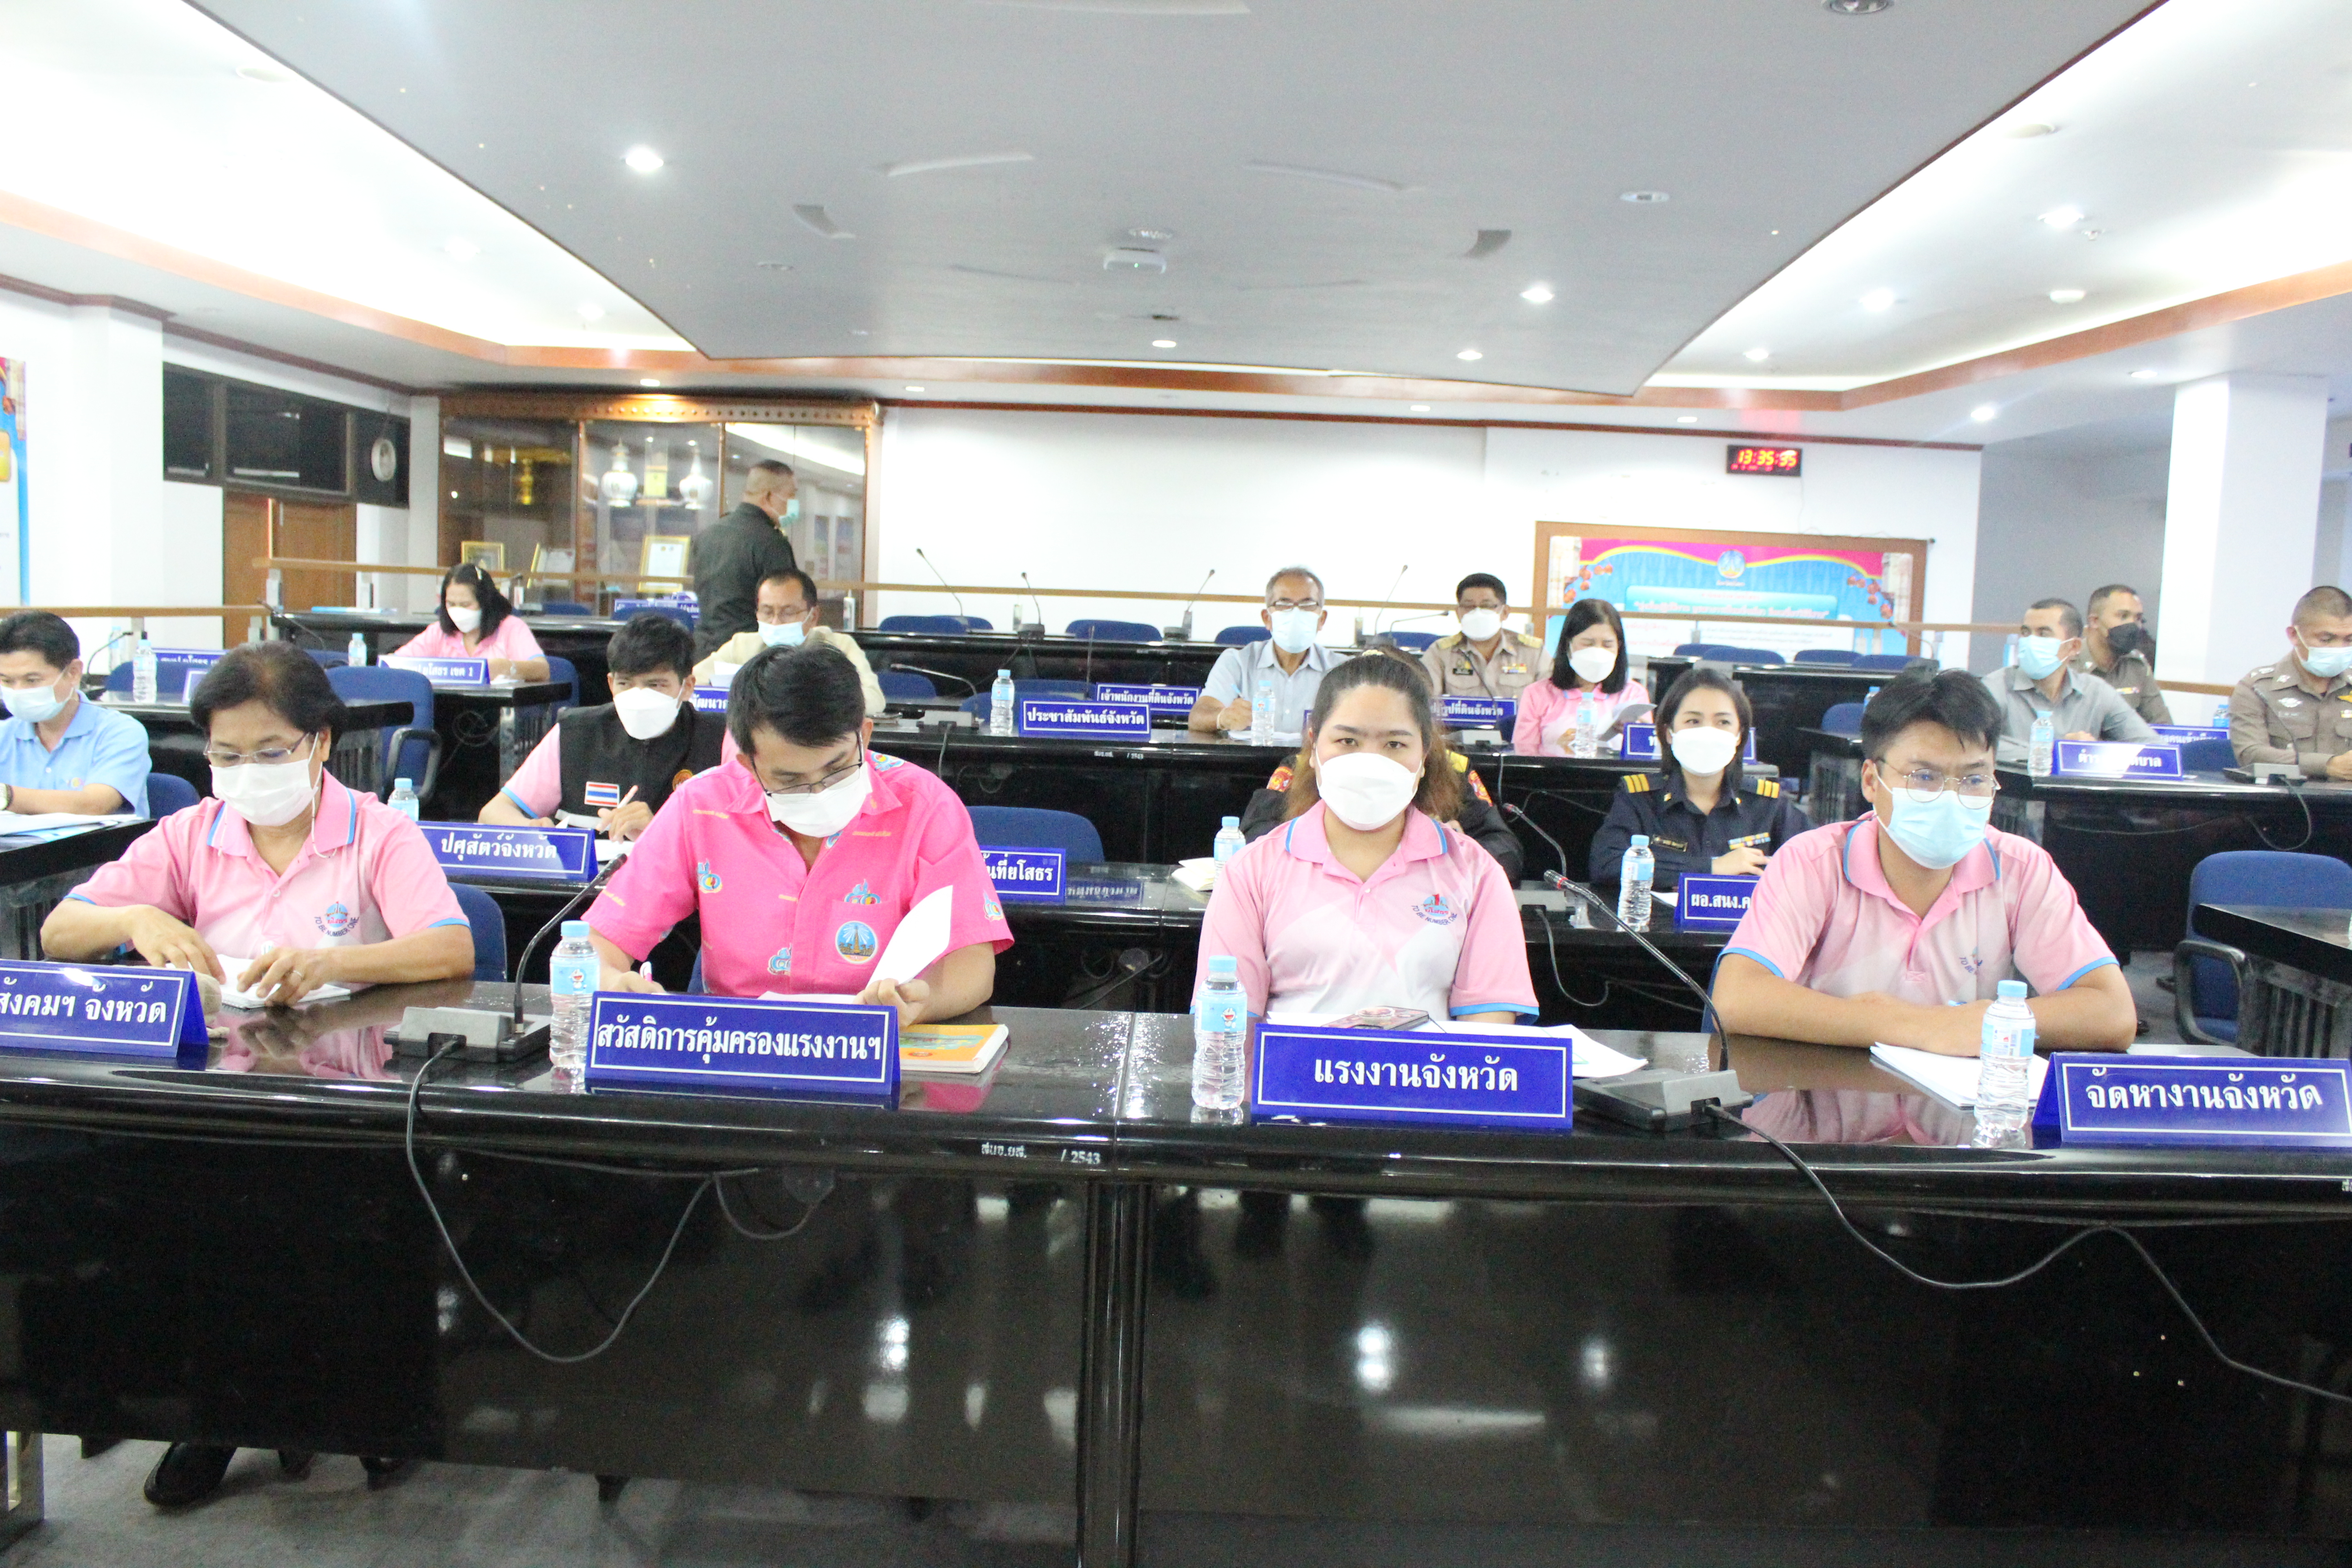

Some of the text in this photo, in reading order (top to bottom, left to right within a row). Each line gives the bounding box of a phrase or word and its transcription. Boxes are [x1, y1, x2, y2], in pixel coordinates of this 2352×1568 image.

[1027, 706, 1145, 725] ประชาสัมพันธ์จังหวัด
[441, 832, 557, 861] ปศุสัตว์จังหวัด
[314, 916, 323, 924] TO
[325, 928, 350, 937] NUMBER
[347, 916, 359, 928] ONE
[1425, 916, 1451, 925] NUMBER
[85, 981, 167, 1024] จังหวัด
[598, 1013, 881, 1064] สวัสดิการคุ้มครองแรงงานฯ
[1315, 1053, 1517, 1091] แรงงานจังหวัด
[2086, 1067, 2323, 1110] จัดหางานจังหวัด
[1071, 1151, 1101, 1165] 2543
